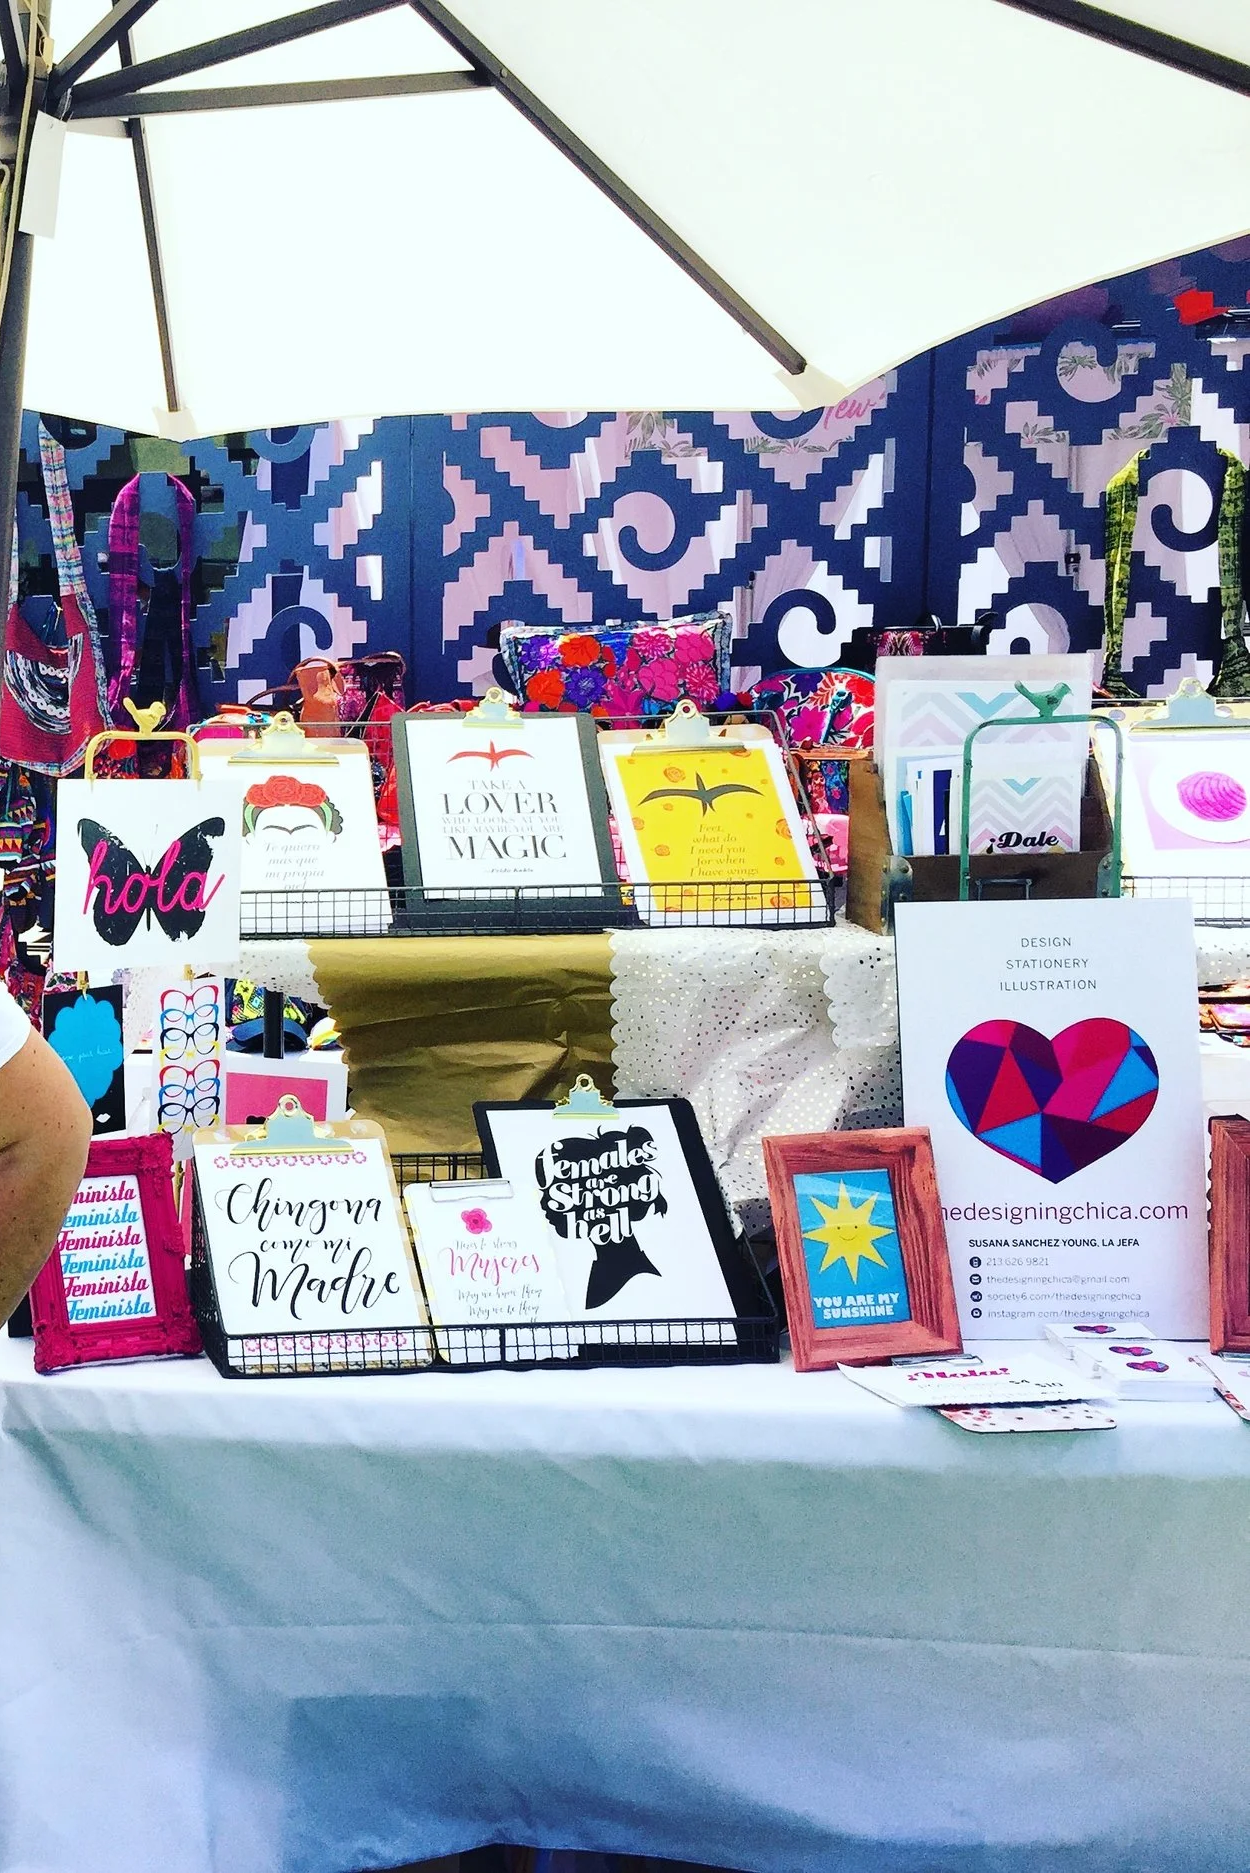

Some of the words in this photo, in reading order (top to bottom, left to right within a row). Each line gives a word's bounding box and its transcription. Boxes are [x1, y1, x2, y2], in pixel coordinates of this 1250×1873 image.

[467, 779, 511, 790] TAKE
[517, 779, 526, 790] A
[439, 791, 561, 815] LOVER
[443, 834, 567, 860] MAGIC
[692, 834, 720, 843] what
[723, 833, 737, 842] do
[698, 844, 724, 854] need
[727, 847, 746, 856] you
[696, 857, 712, 868] for
[716, 854, 745, 865] when
[82, 839, 225, 915] hola
[698, 867, 724, 877] have
[727, 867, 758, 876] wings
[1021, 937, 1071, 948] DESIGN
[1006, 958, 1089, 969] STATIONERY
[1000, 979, 1097, 992] ILLUSTRATION
[585, 1174, 618, 1189] are
[73, 1180, 136, 1204] minista
[63, 1203, 140, 1228] eminista
[214, 1177, 382, 1235] Chingona
[583, 1207, 606, 1221] as
[941, 1202, 1188, 1225] edesigningchica.com
[563, 1206, 632, 1245] hell
[58, 1225, 143, 1251] Feminista
[968, 1238, 1010, 1248] SUSANA
[1012, 1238, 1060, 1248] SANCHEZ
[1061, 1238, 1100, 1248] YOUNG,
[1102, 1238, 1115, 1247] LA
[1116, 1238, 1140, 1247] JEFA
[260, 1238, 318, 1264] como
[324, 1237, 351, 1264] mi
[61, 1248, 147, 1274] Feminista
[986, 1257, 1003, 1267] 213
[1005, 1257, 1024, 1266] 626
[1025, 1256, 1050, 1266] 9821
[63, 1270, 149, 1297] Feminista
[228, 1247, 400, 1320] Madre
[66, 1293, 153, 1321] Feminista
[813, 1296, 842, 1308] YOU
[845, 1294, 875, 1307] ARE
[878, 1292, 900, 1305] MY
[823, 1304, 895, 1320] SUNSHINE
